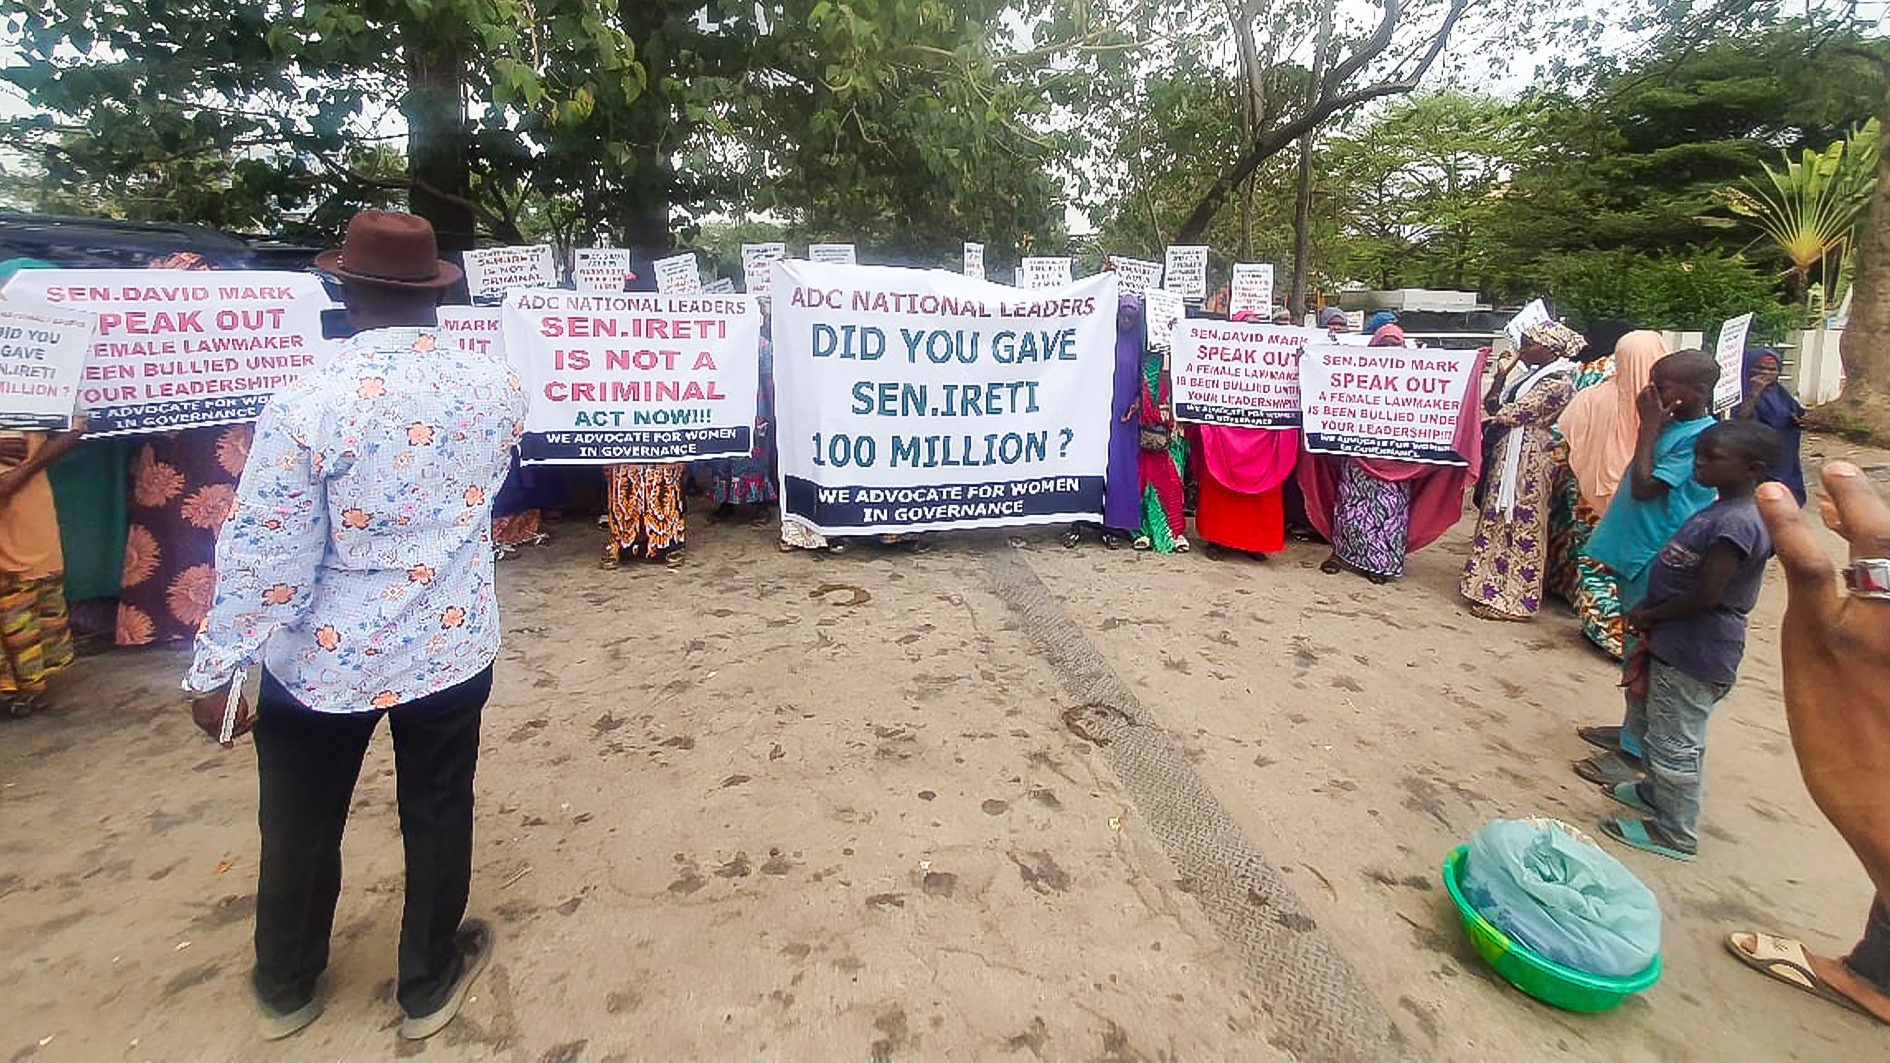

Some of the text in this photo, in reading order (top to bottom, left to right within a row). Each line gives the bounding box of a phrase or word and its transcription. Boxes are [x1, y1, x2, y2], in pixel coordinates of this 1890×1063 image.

[47, 285, 296, 302] SEN.DAVID MARK
[790, 286, 1096, 318] ADC NATIONAL LEADERS
[517, 294, 746, 315] ADC NATIONAL LEADERS
[97, 312, 205, 335] PEAK
[215, 308, 286, 332] OUT
[444, 318, 499, 332] MARK
[540, 316, 726, 339] SEN.IRETI
[28, 329, 61, 344] YOU
[93, 335, 304, 358] EMALE LAWMAKER
[812, 323, 1078, 364] DID YOU GAVE
[1190, 328, 1308, 346] SEN.DAVID MARK
[1, 344, 46, 360] GAVE
[554, 350, 718, 371] IS NOT A
[1196, 344, 1302, 367] SPEAK OUT
[86, 354, 315, 381] EEN BULLIED UNDER
[1185, 363, 1299, 381] A FEMALE LAWMAKE
[1322, 354, 1460, 373] SEN.DAVID MARK
[543, 381, 727, 402] CRIMINAL
[1176, 376, 1186, 386] IS
[1190, 377, 1220, 389] BEEN
[1223, 381, 1270, 394] BULLIED
[1330, 373, 1452, 394] SPEAK OUT
[852, 381, 1040, 416] SEN.IRETI
[1188, 391, 1218, 403] YOUR
[1318, 391, 1461, 411] A FEMALE LAWMAKER
[107, 401, 200, 419] ADVOCATE
[205, 397, 237, 409] FOR
[114, 406, 257, 428] IN GOVERNANCE
[574, 408, 712, 427] ACT NOW!!!
[1308, 405, 1319, 416] IS
[1323, 406, 1356, 419] BEEN
[1360, 409, 1415, 422] BULLIED
[546, 428, 737, 444] WE ADVOCATE FOR WOMEN
[1320, 420, 1355, 433] YOUR
[579, 443, 697, 457] IN GOVERNANCE
[812, 427, 1074, 467] 100 MILLION ?
[819, 477, 1080, 504] WE ADVOCATE FOR WOMEN
[863, 499, 1025, 523] IN GOVERNANCE
